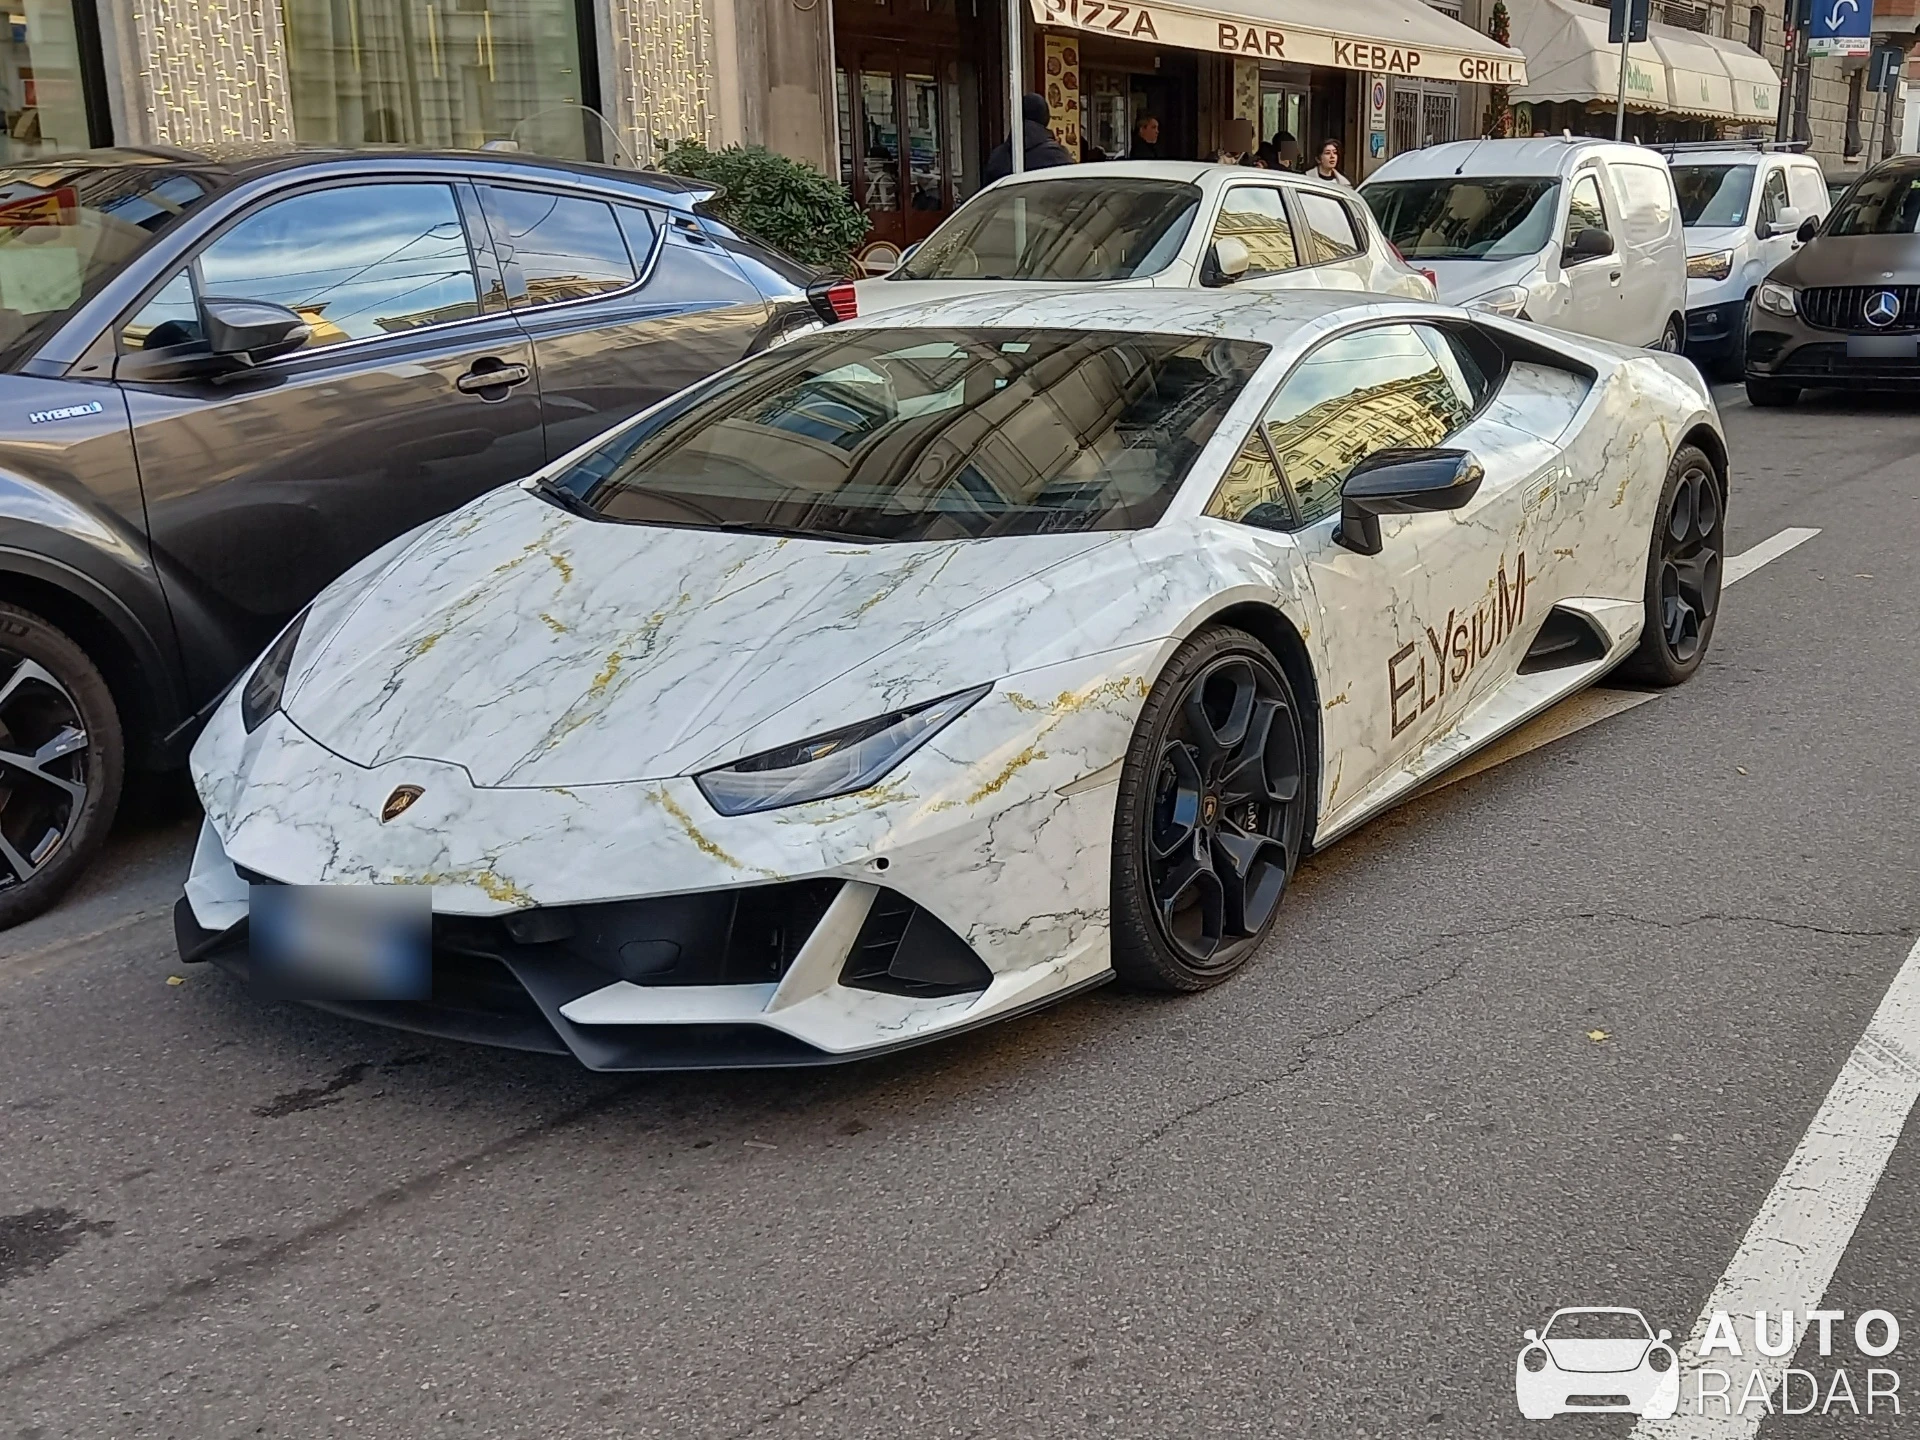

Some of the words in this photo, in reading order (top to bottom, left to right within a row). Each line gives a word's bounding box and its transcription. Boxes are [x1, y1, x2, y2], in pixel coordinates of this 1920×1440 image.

[1045, 0, 1158, 40] PIZZA
[1217, 23, 1285, 58] BAR
[1334, 40, 1420, 73] KEBAP
[1459, 58, 1521, 82] GRILL
[29, 402, 95, 424] HYBRID
